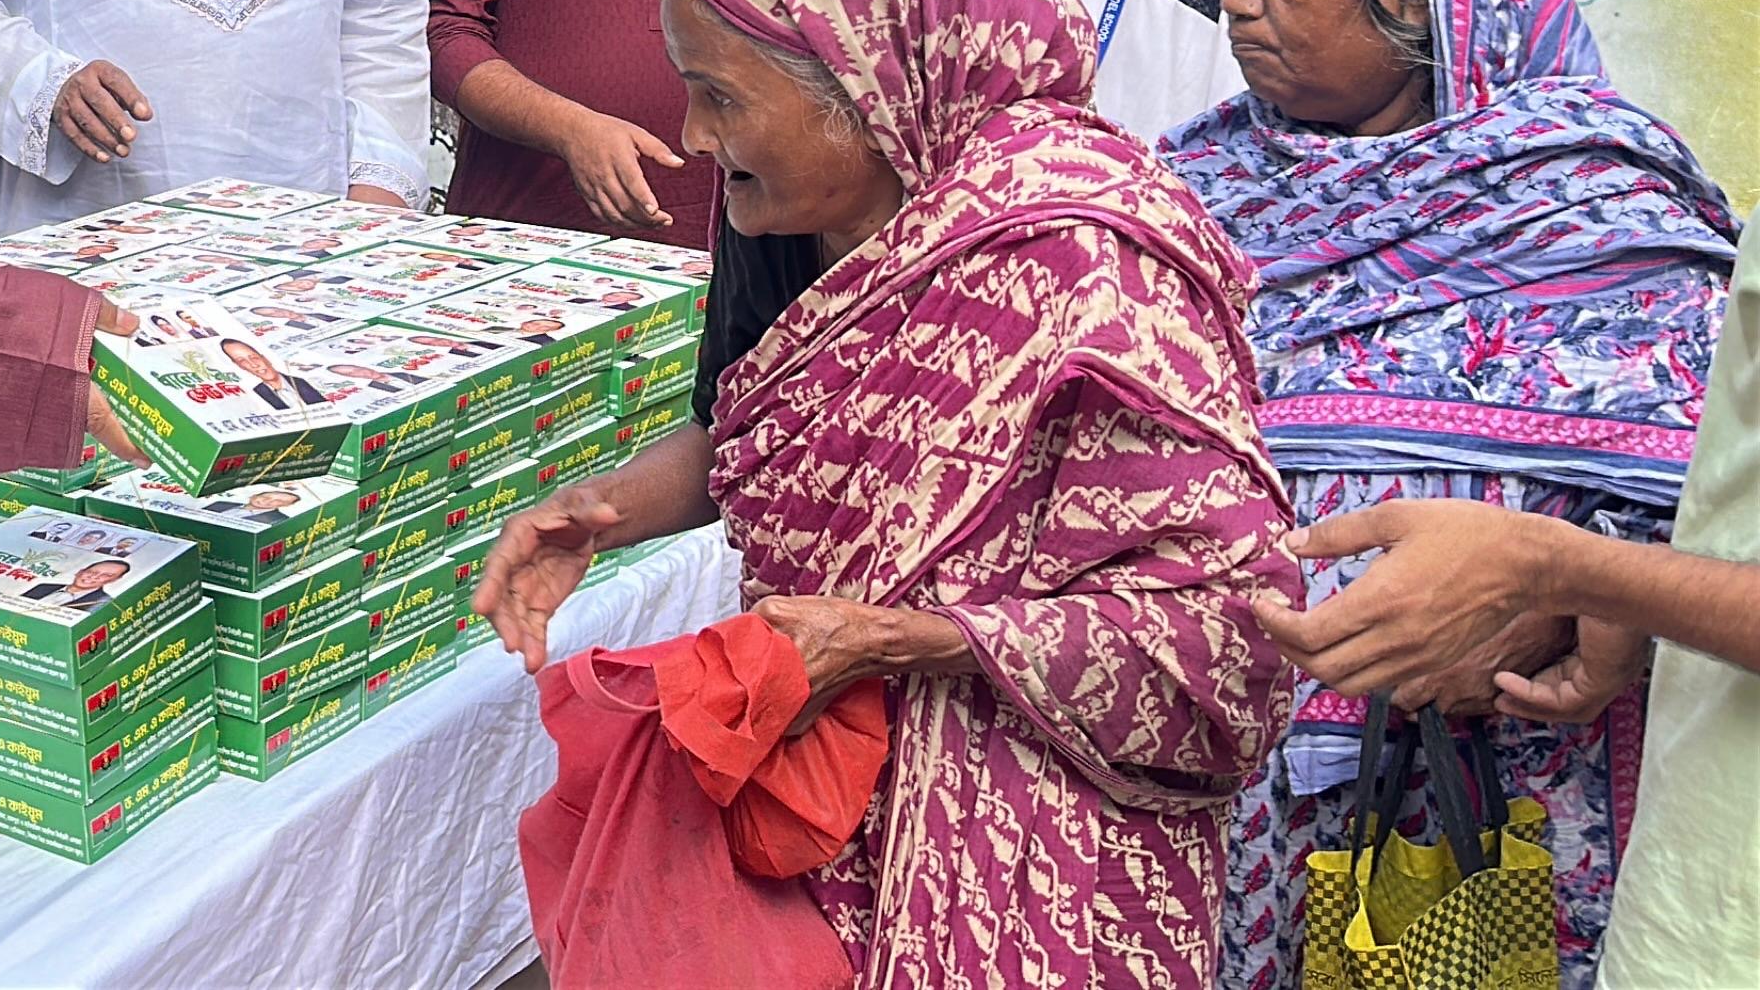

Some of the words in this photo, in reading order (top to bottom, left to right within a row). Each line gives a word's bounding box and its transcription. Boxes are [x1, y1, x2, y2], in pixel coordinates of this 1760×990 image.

[128, 393, 139, 406] এ
[187, 383, 221, 403] ভোট
[7, 568, 38, 582] দিন
